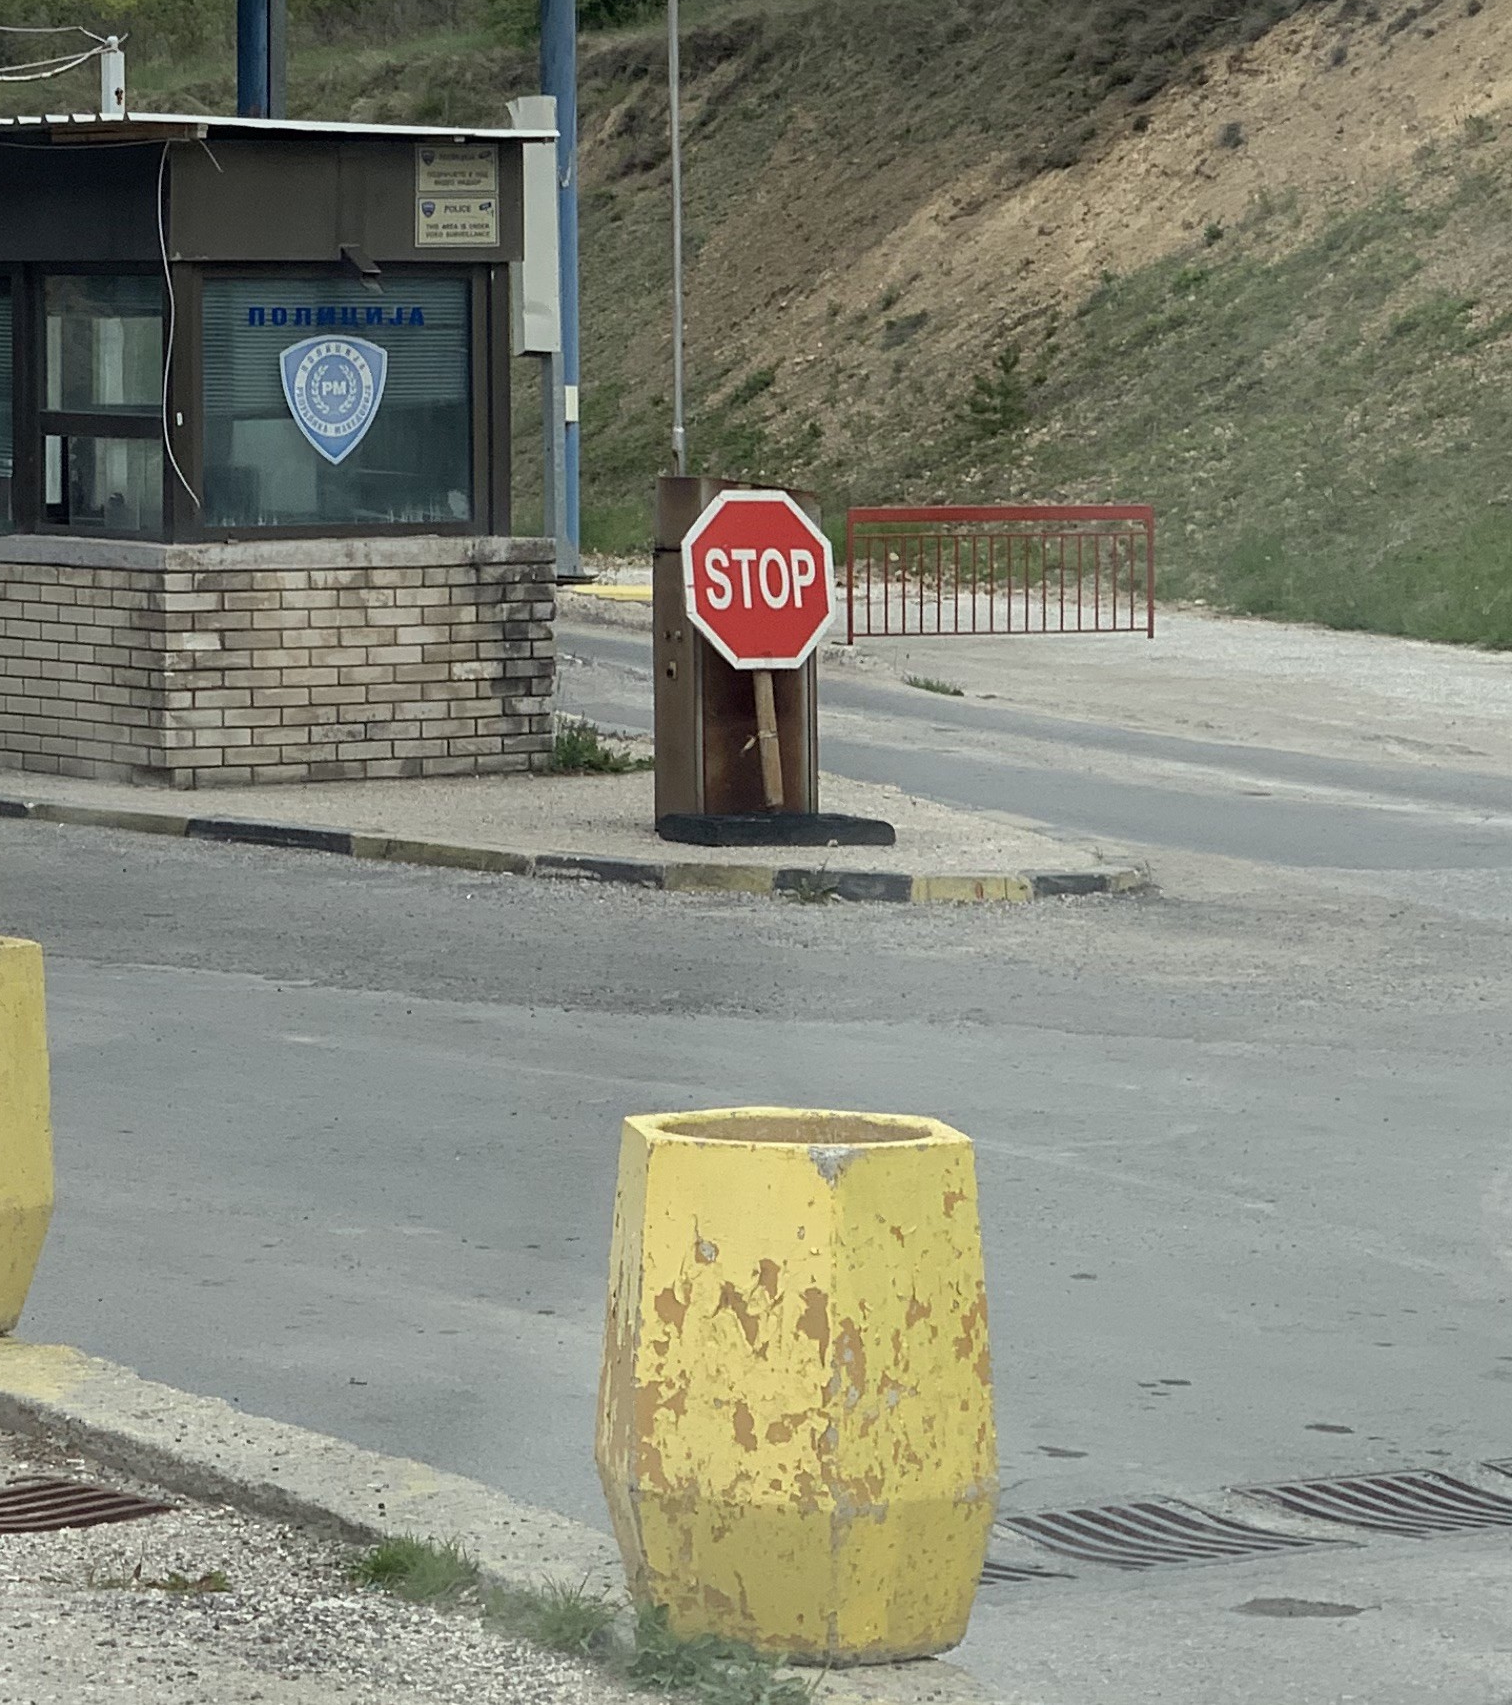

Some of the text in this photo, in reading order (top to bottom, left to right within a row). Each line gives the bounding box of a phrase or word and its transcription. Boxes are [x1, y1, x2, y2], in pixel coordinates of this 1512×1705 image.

[444, 205, 471, 213] POLICE
[249, 306, 424, 327] ПОЛИЦИЈА
[704, 547, 816, 610] STOP
